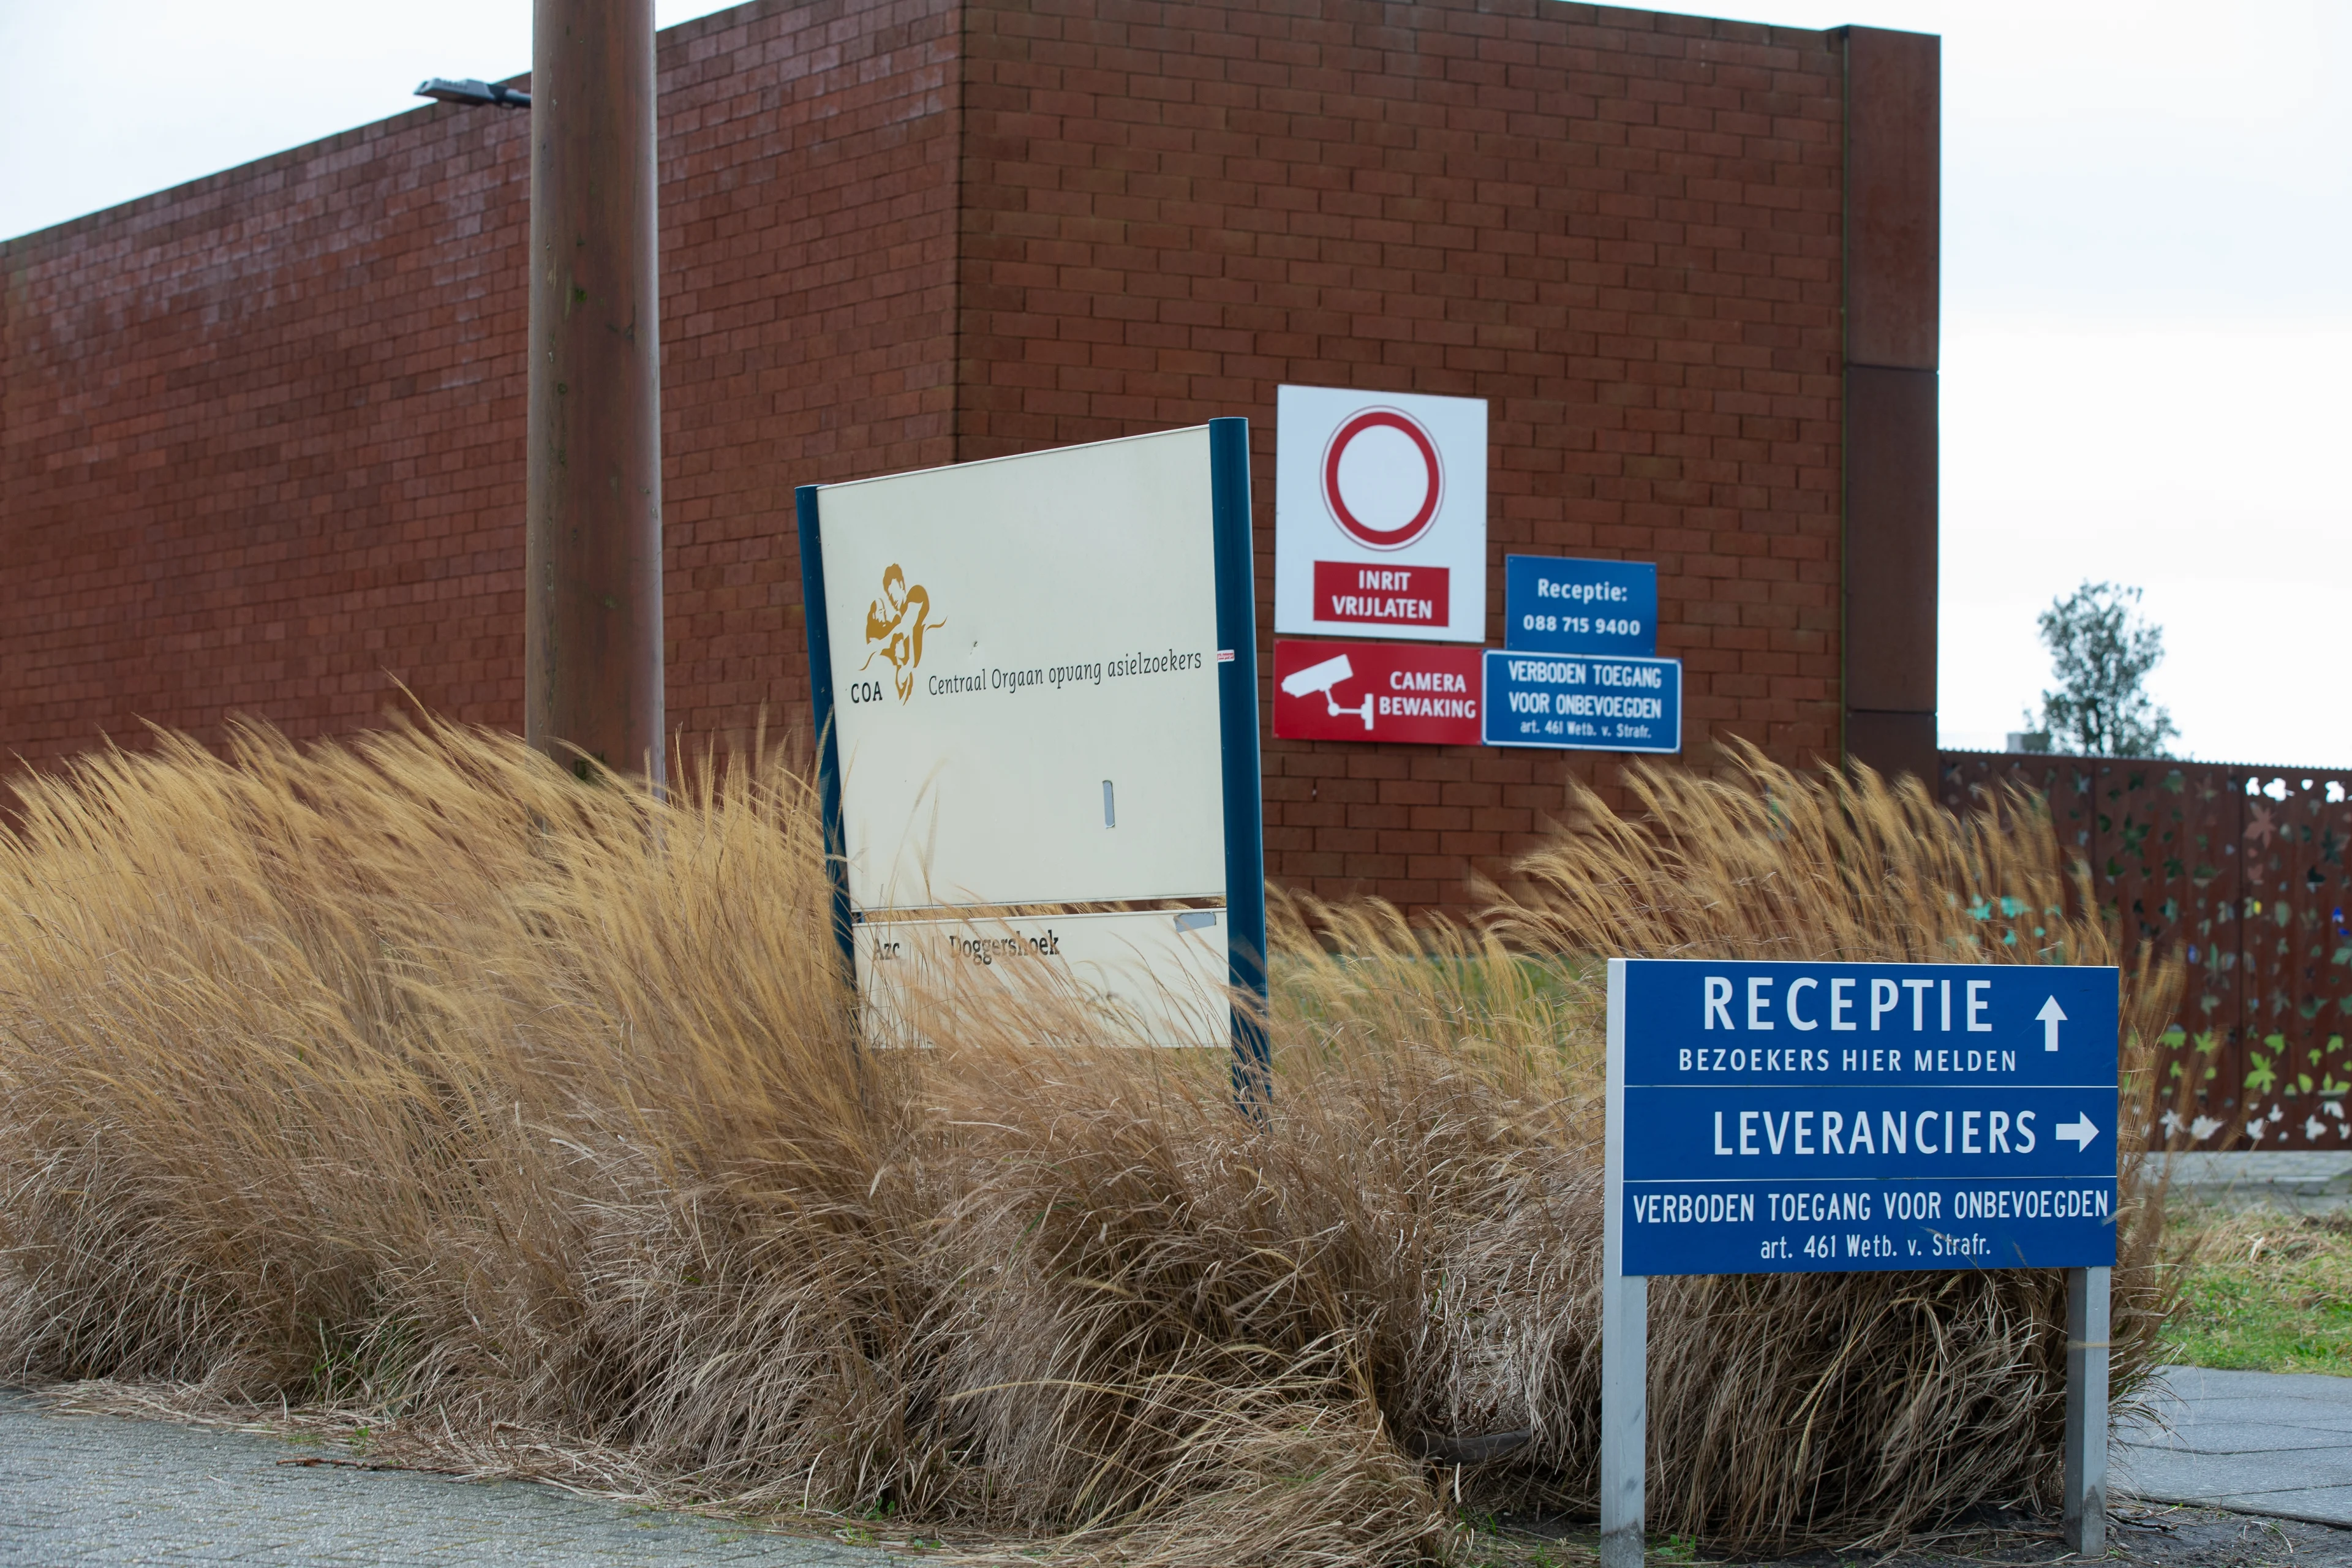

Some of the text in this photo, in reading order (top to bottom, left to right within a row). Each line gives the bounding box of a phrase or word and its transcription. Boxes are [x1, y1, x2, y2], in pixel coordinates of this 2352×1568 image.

[1359, 570, 1411, 591] INRIT
[1538, 578, 1627, 604] Receptie:
[1332, 595, 1433, 619] VRIJLATEN
[1523, 614, 1640, 635] 088 715 9400
[929, 649, 1202, 696] Centraal Orgaan opvang asielzoekers
[1390, 671, 1466, 693] CAMERA
[1508, 660, 1662, 688] VERBODEN TOEGANG
[851, 681, 883, 704] COA
[1509, 692, 1662, 718] VOOR ONBEVOEGDEN
[1379, 696, 1476, 718] BEWAKING
[1520, 720, 1651, 738] art. 461 Wetb. v. Strafr.
[1705, 976, 1992, 1032] RECEPTIE
[1679, 1049, 2015, 1071] BEZOEKERS HIER MELDEN
[1714, 1110, 2036, 1155] LEVERANCIERS
[1633, 1190, 2108, 1223] VERBODEN TOEGANG VOOR ONBEVOEGDEN
[1761, 1233, 1991, 1259] art. 461 Wetb. v. Strafr.
